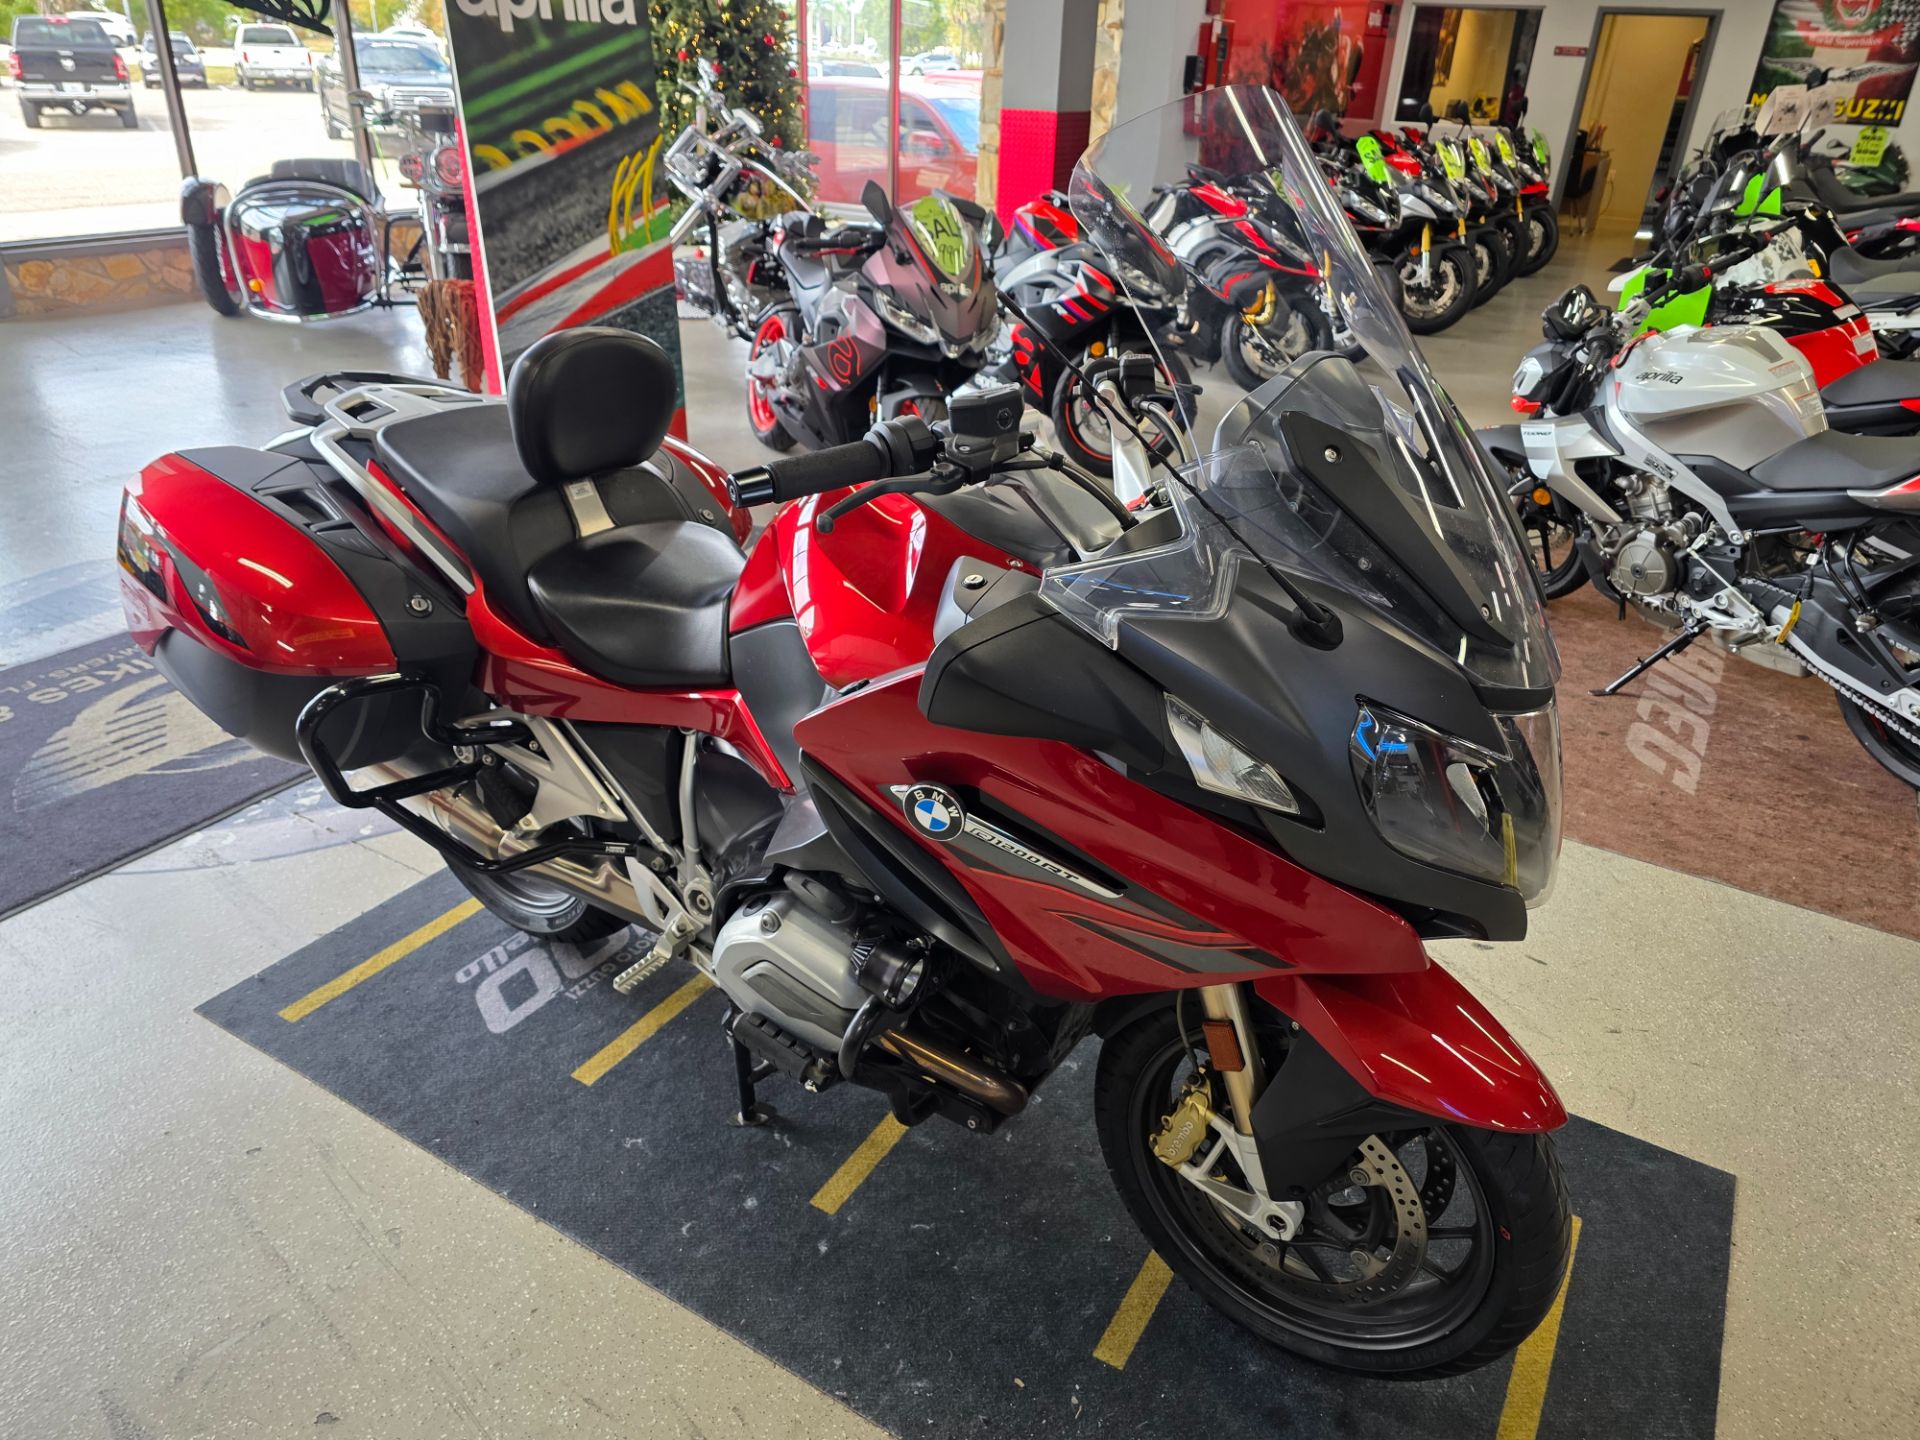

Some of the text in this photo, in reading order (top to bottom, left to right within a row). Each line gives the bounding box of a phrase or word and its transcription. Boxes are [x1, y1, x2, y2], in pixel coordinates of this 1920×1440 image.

[1635, 370, 1684, 385] aprilia
[27, 659, 155, 704] IKES
[914, 789, 961, 818] BMW
[456, 929, 540, 984] ello
[563, 963, 617, 1000] GUZZI
[1168, 1120, 1194, 1156] brembo
